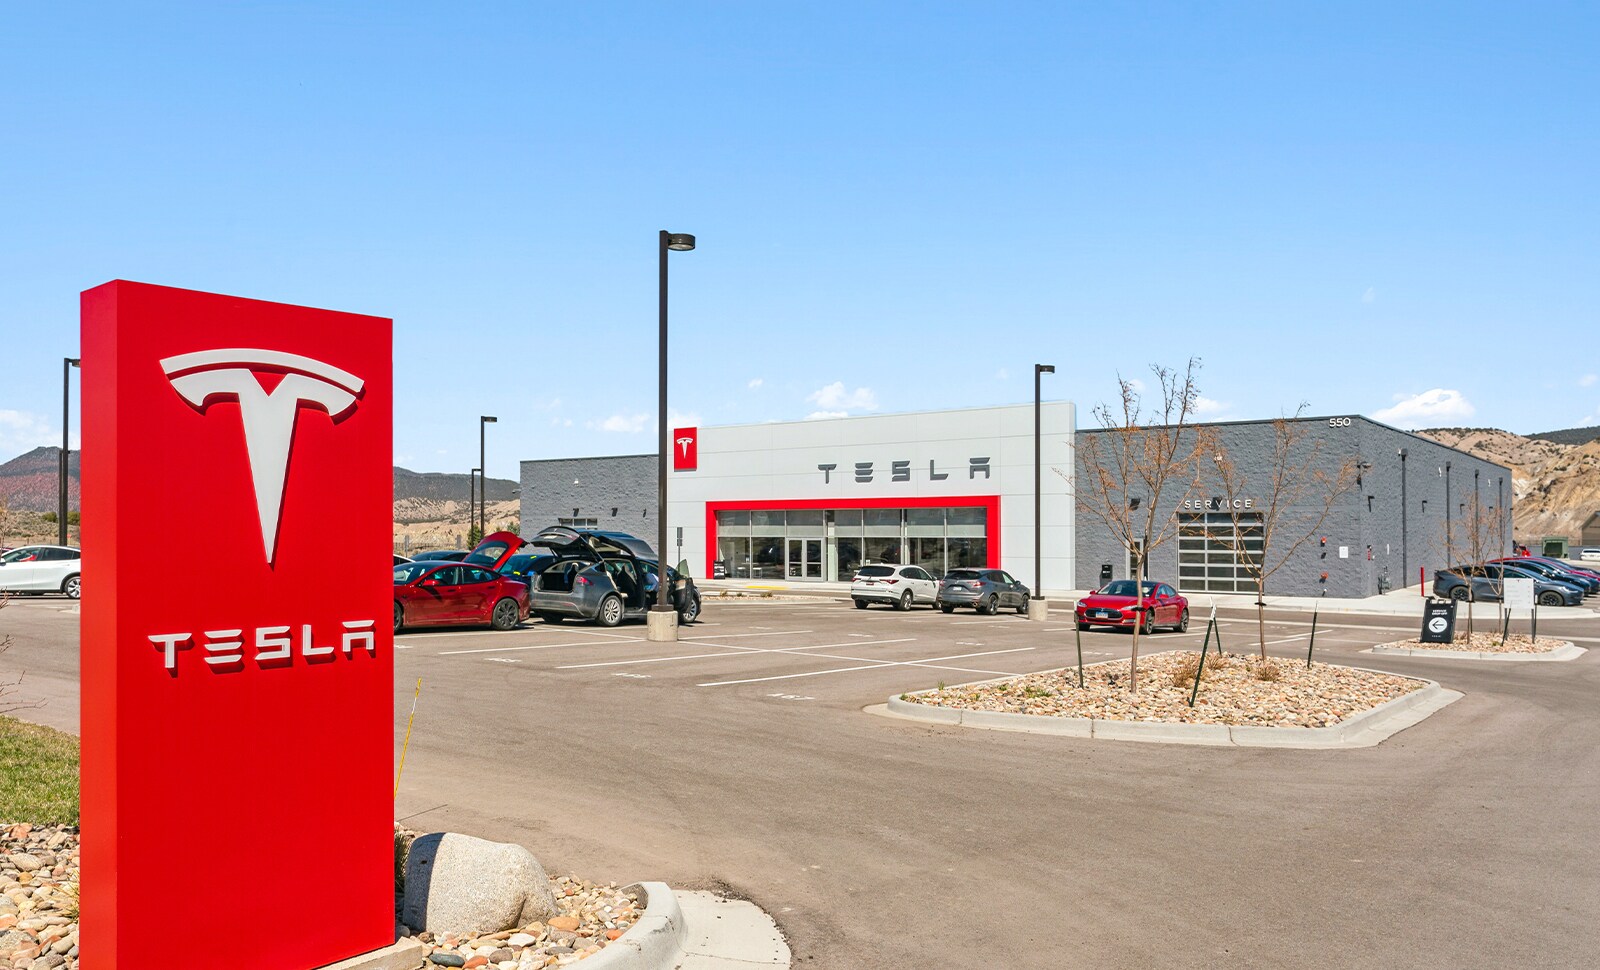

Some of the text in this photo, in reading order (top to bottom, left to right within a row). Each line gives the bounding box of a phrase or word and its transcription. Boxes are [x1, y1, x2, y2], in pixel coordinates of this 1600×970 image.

[1329, 416, 1351, 428] 550
[817, 456, 991, 485] TESLA
[1184, 498, 1252, 510] SERVICE
[147, 619, 375, 669] TESLA
